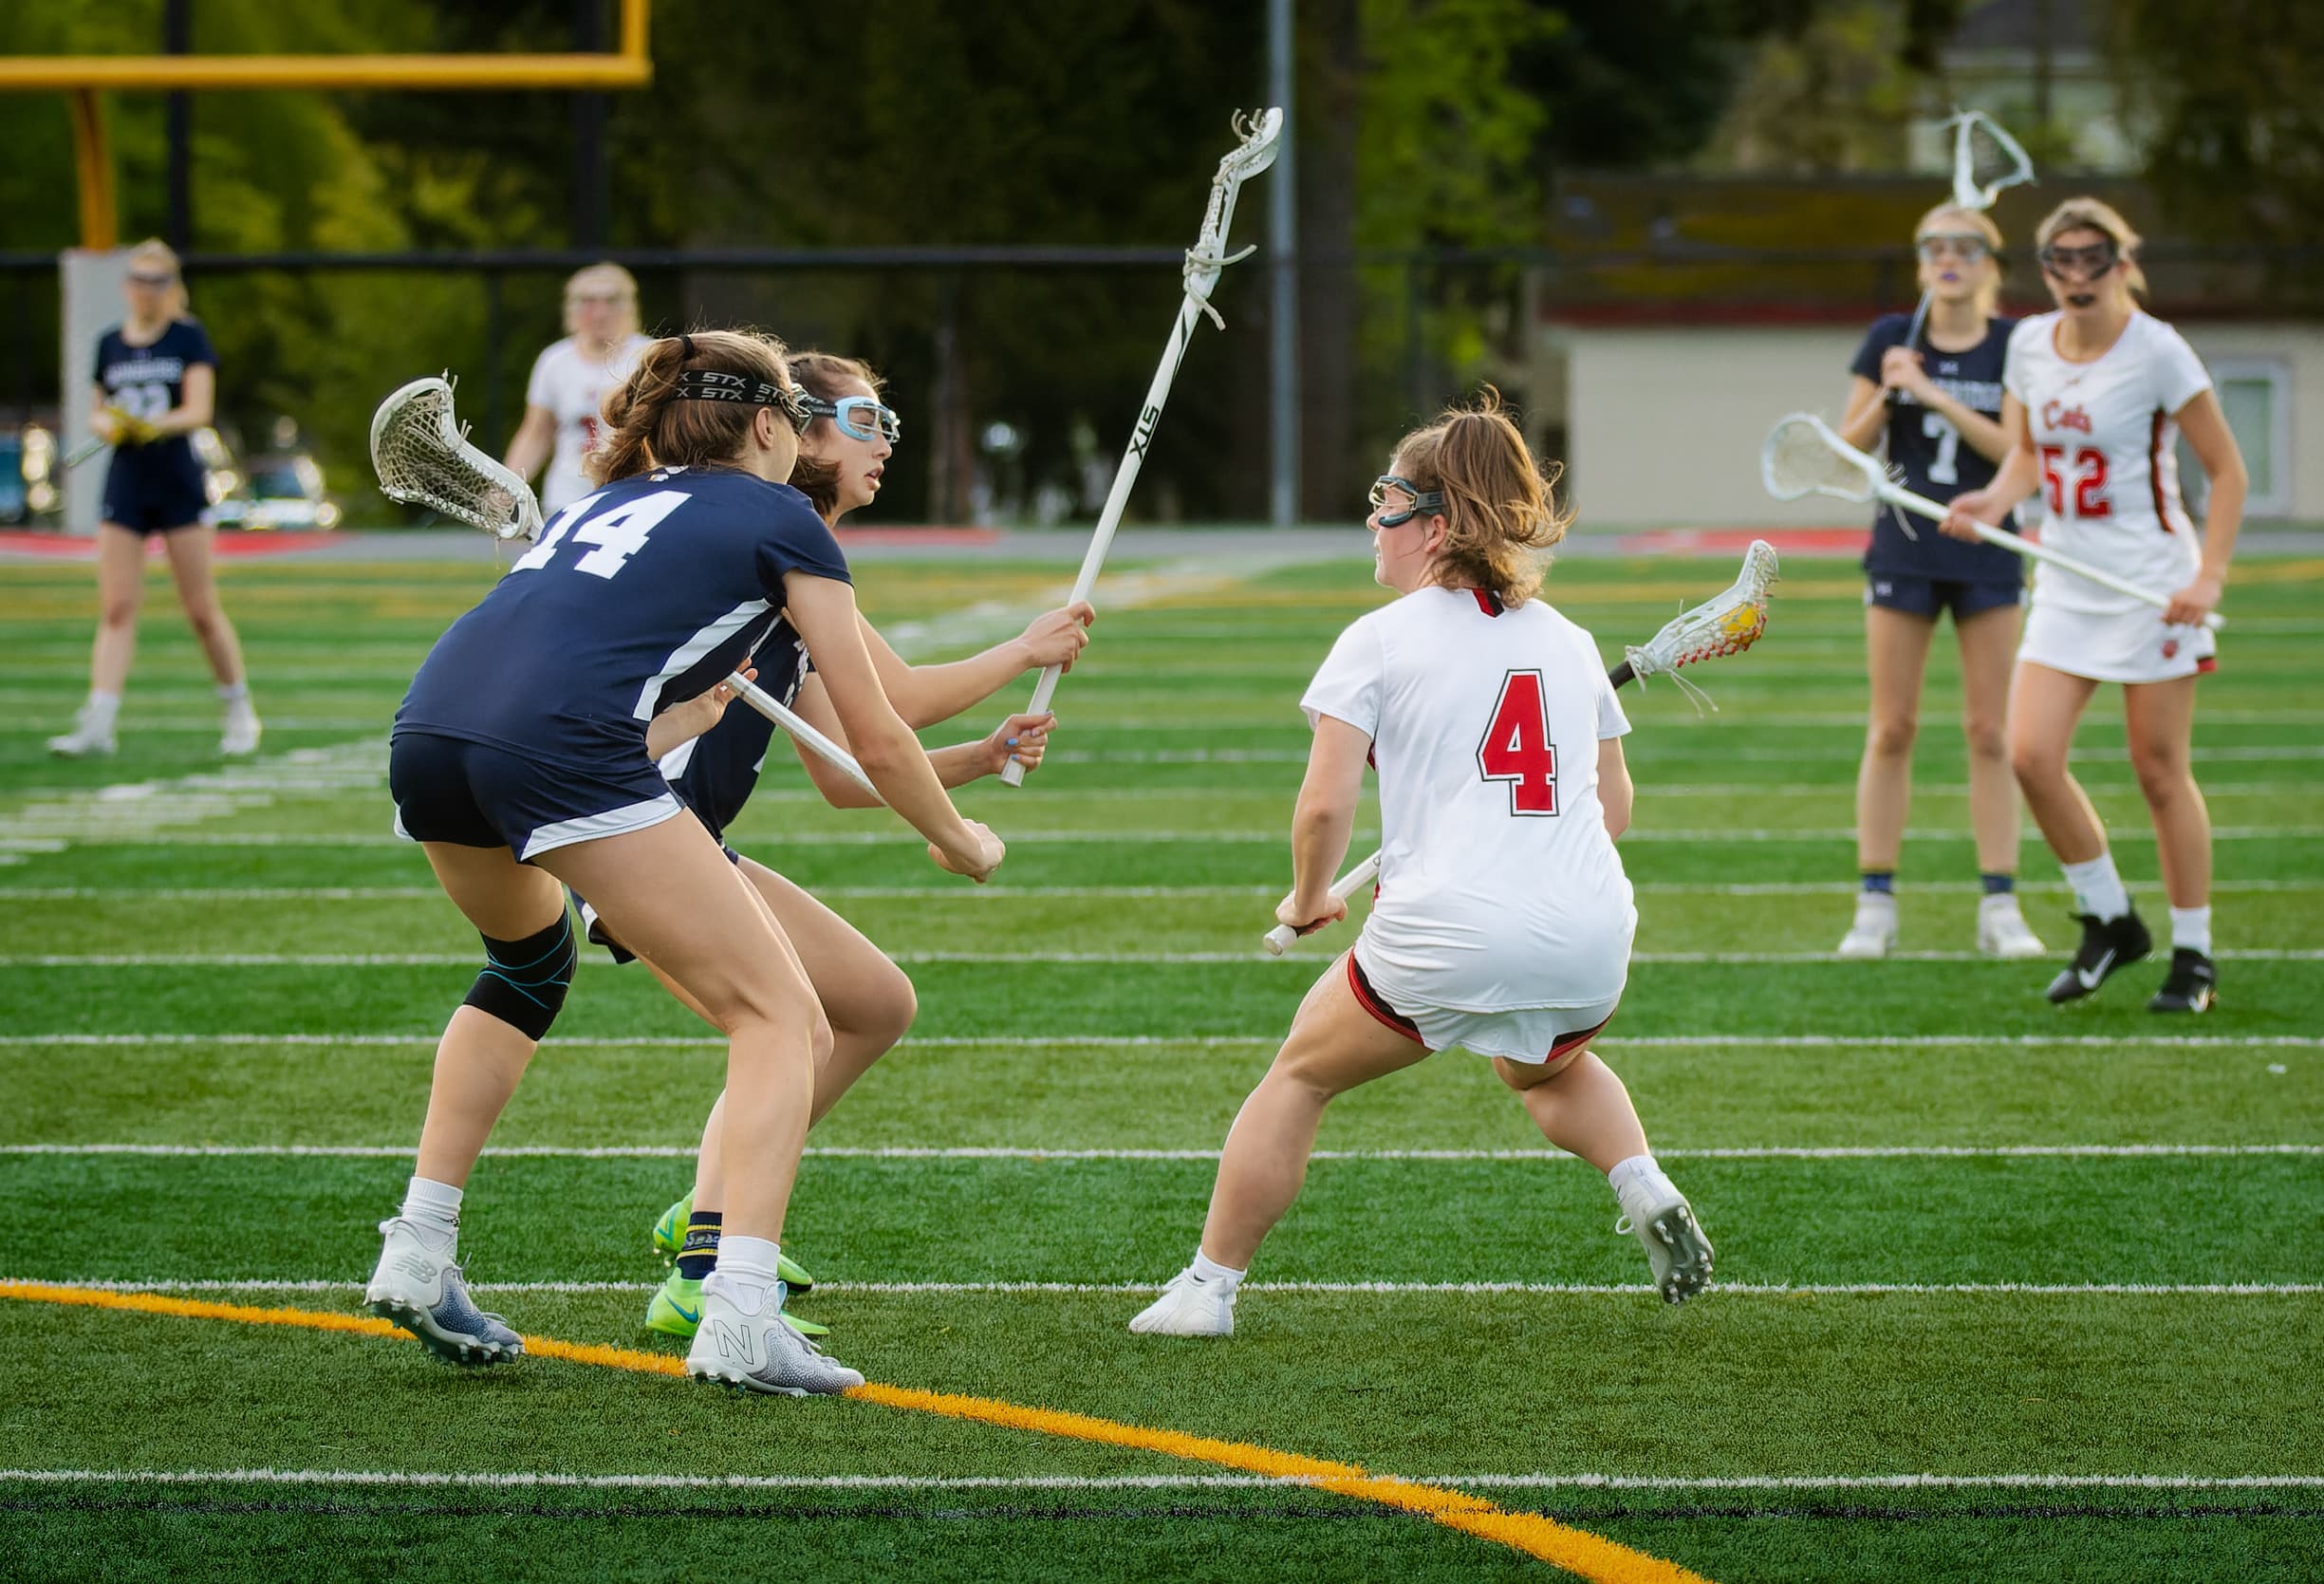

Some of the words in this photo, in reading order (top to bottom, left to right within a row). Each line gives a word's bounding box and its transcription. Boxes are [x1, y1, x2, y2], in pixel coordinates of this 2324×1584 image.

[700, 386, 743, 401] STX
[702, 371, 747, 388] STX
[1129, 404, 1160, 461] STX
[1922, 410, 1959, 486] 7
[2039, 444, 2113, 518] 52
[510, 489, 694, 580] 14
[1476, 667, 1559, 817] 4
[713, 1319, 754, 1365] N
